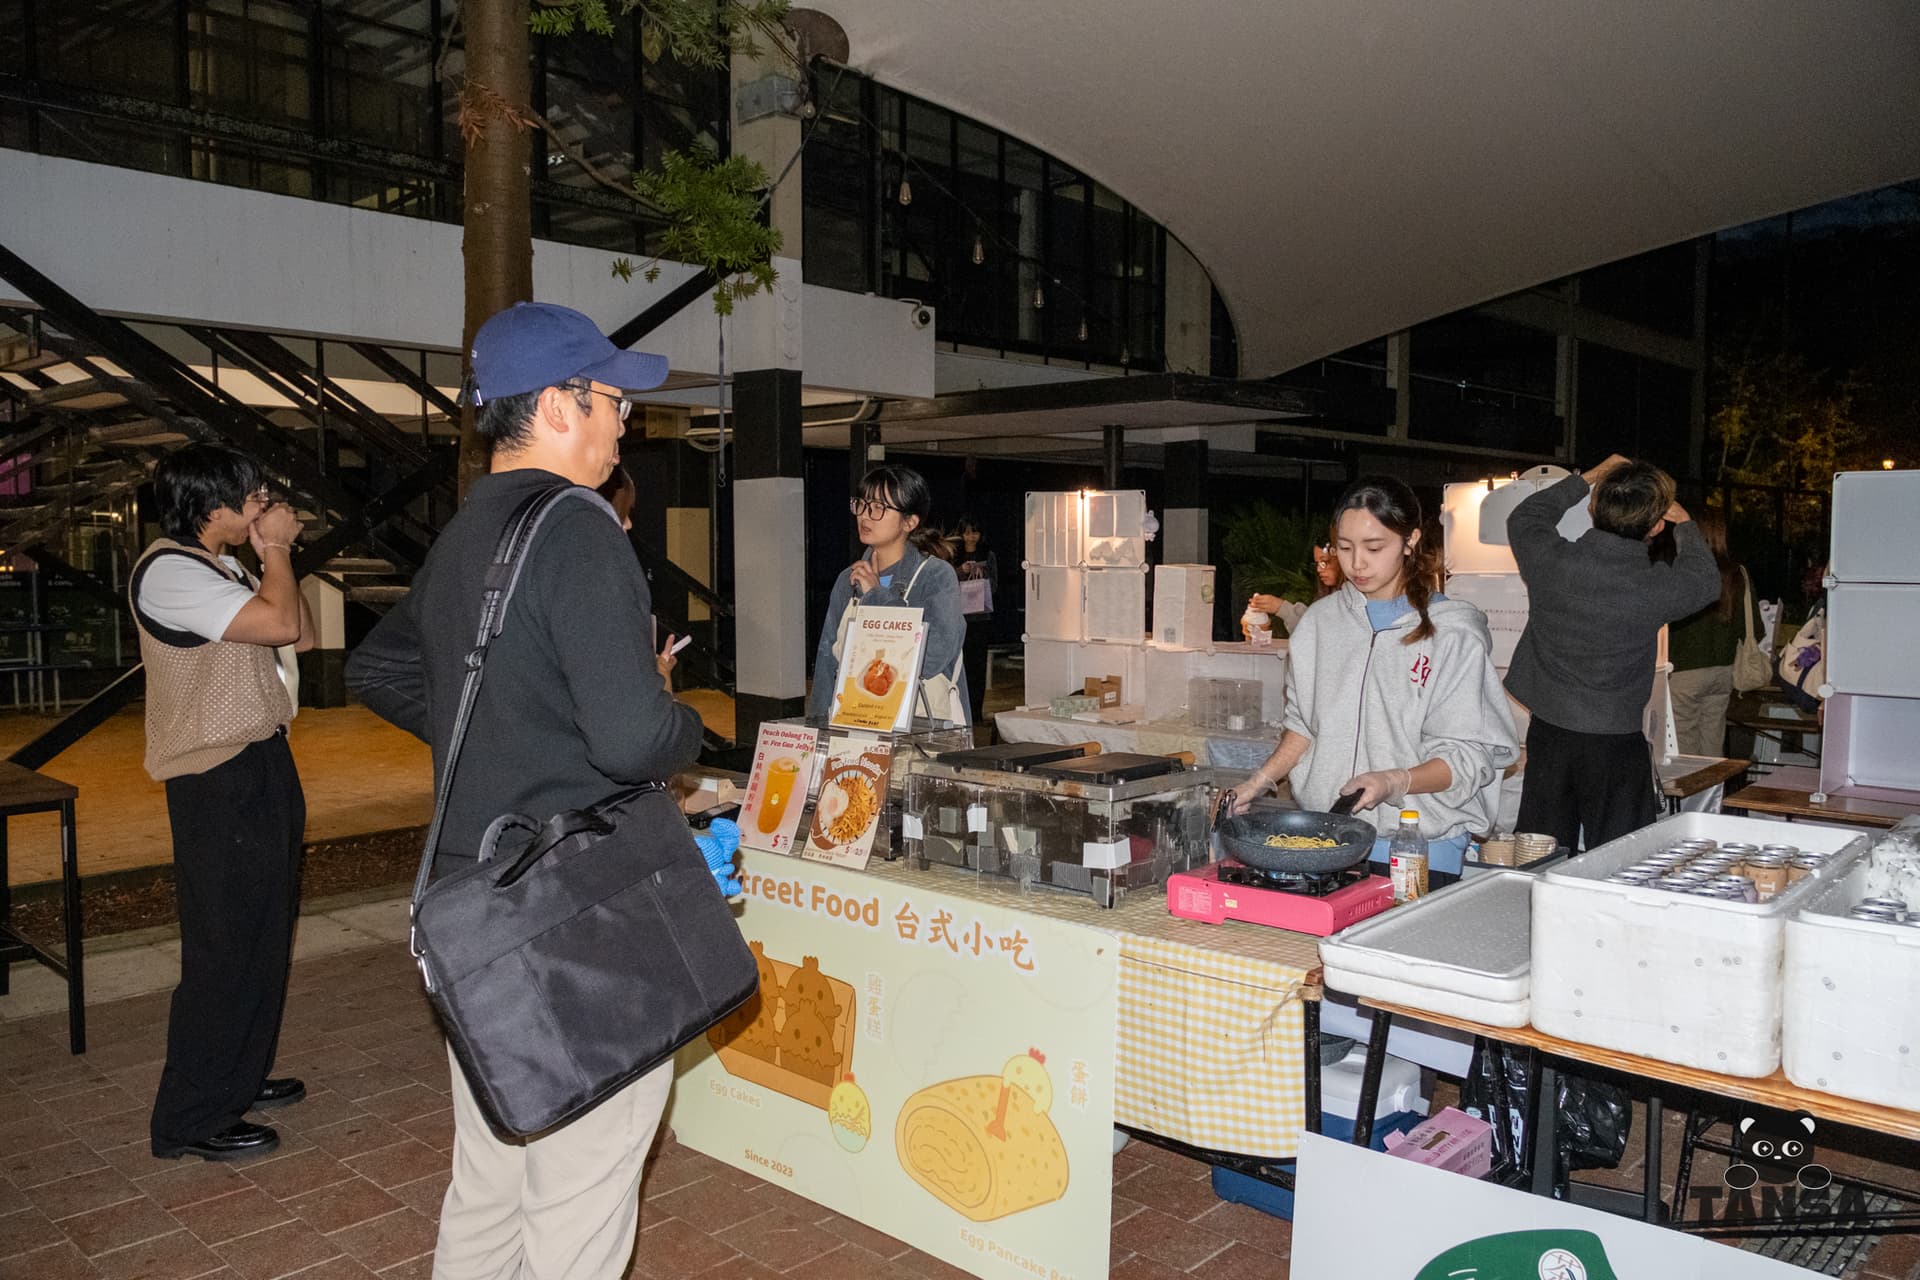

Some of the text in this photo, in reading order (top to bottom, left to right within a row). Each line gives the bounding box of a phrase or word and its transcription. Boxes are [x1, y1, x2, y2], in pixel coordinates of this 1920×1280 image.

[862, 619, 913, 631] EGG CAKES
[762, 728, 814, 742] Peach Oolong Tea
[795, 743, 810, 752] Jelly
[740, 867, 1035, 971] treet Food 台式小吃
[709, 1079, 761, 1107] Egg Cakes
[1071, 1060, 1088, 1108] 蛋餅
[744, 1148, 793, 1178] Since 2023
[960, 1228, 985, 1251] Egg
[988, 1239, 1047, 1277] Pancake
